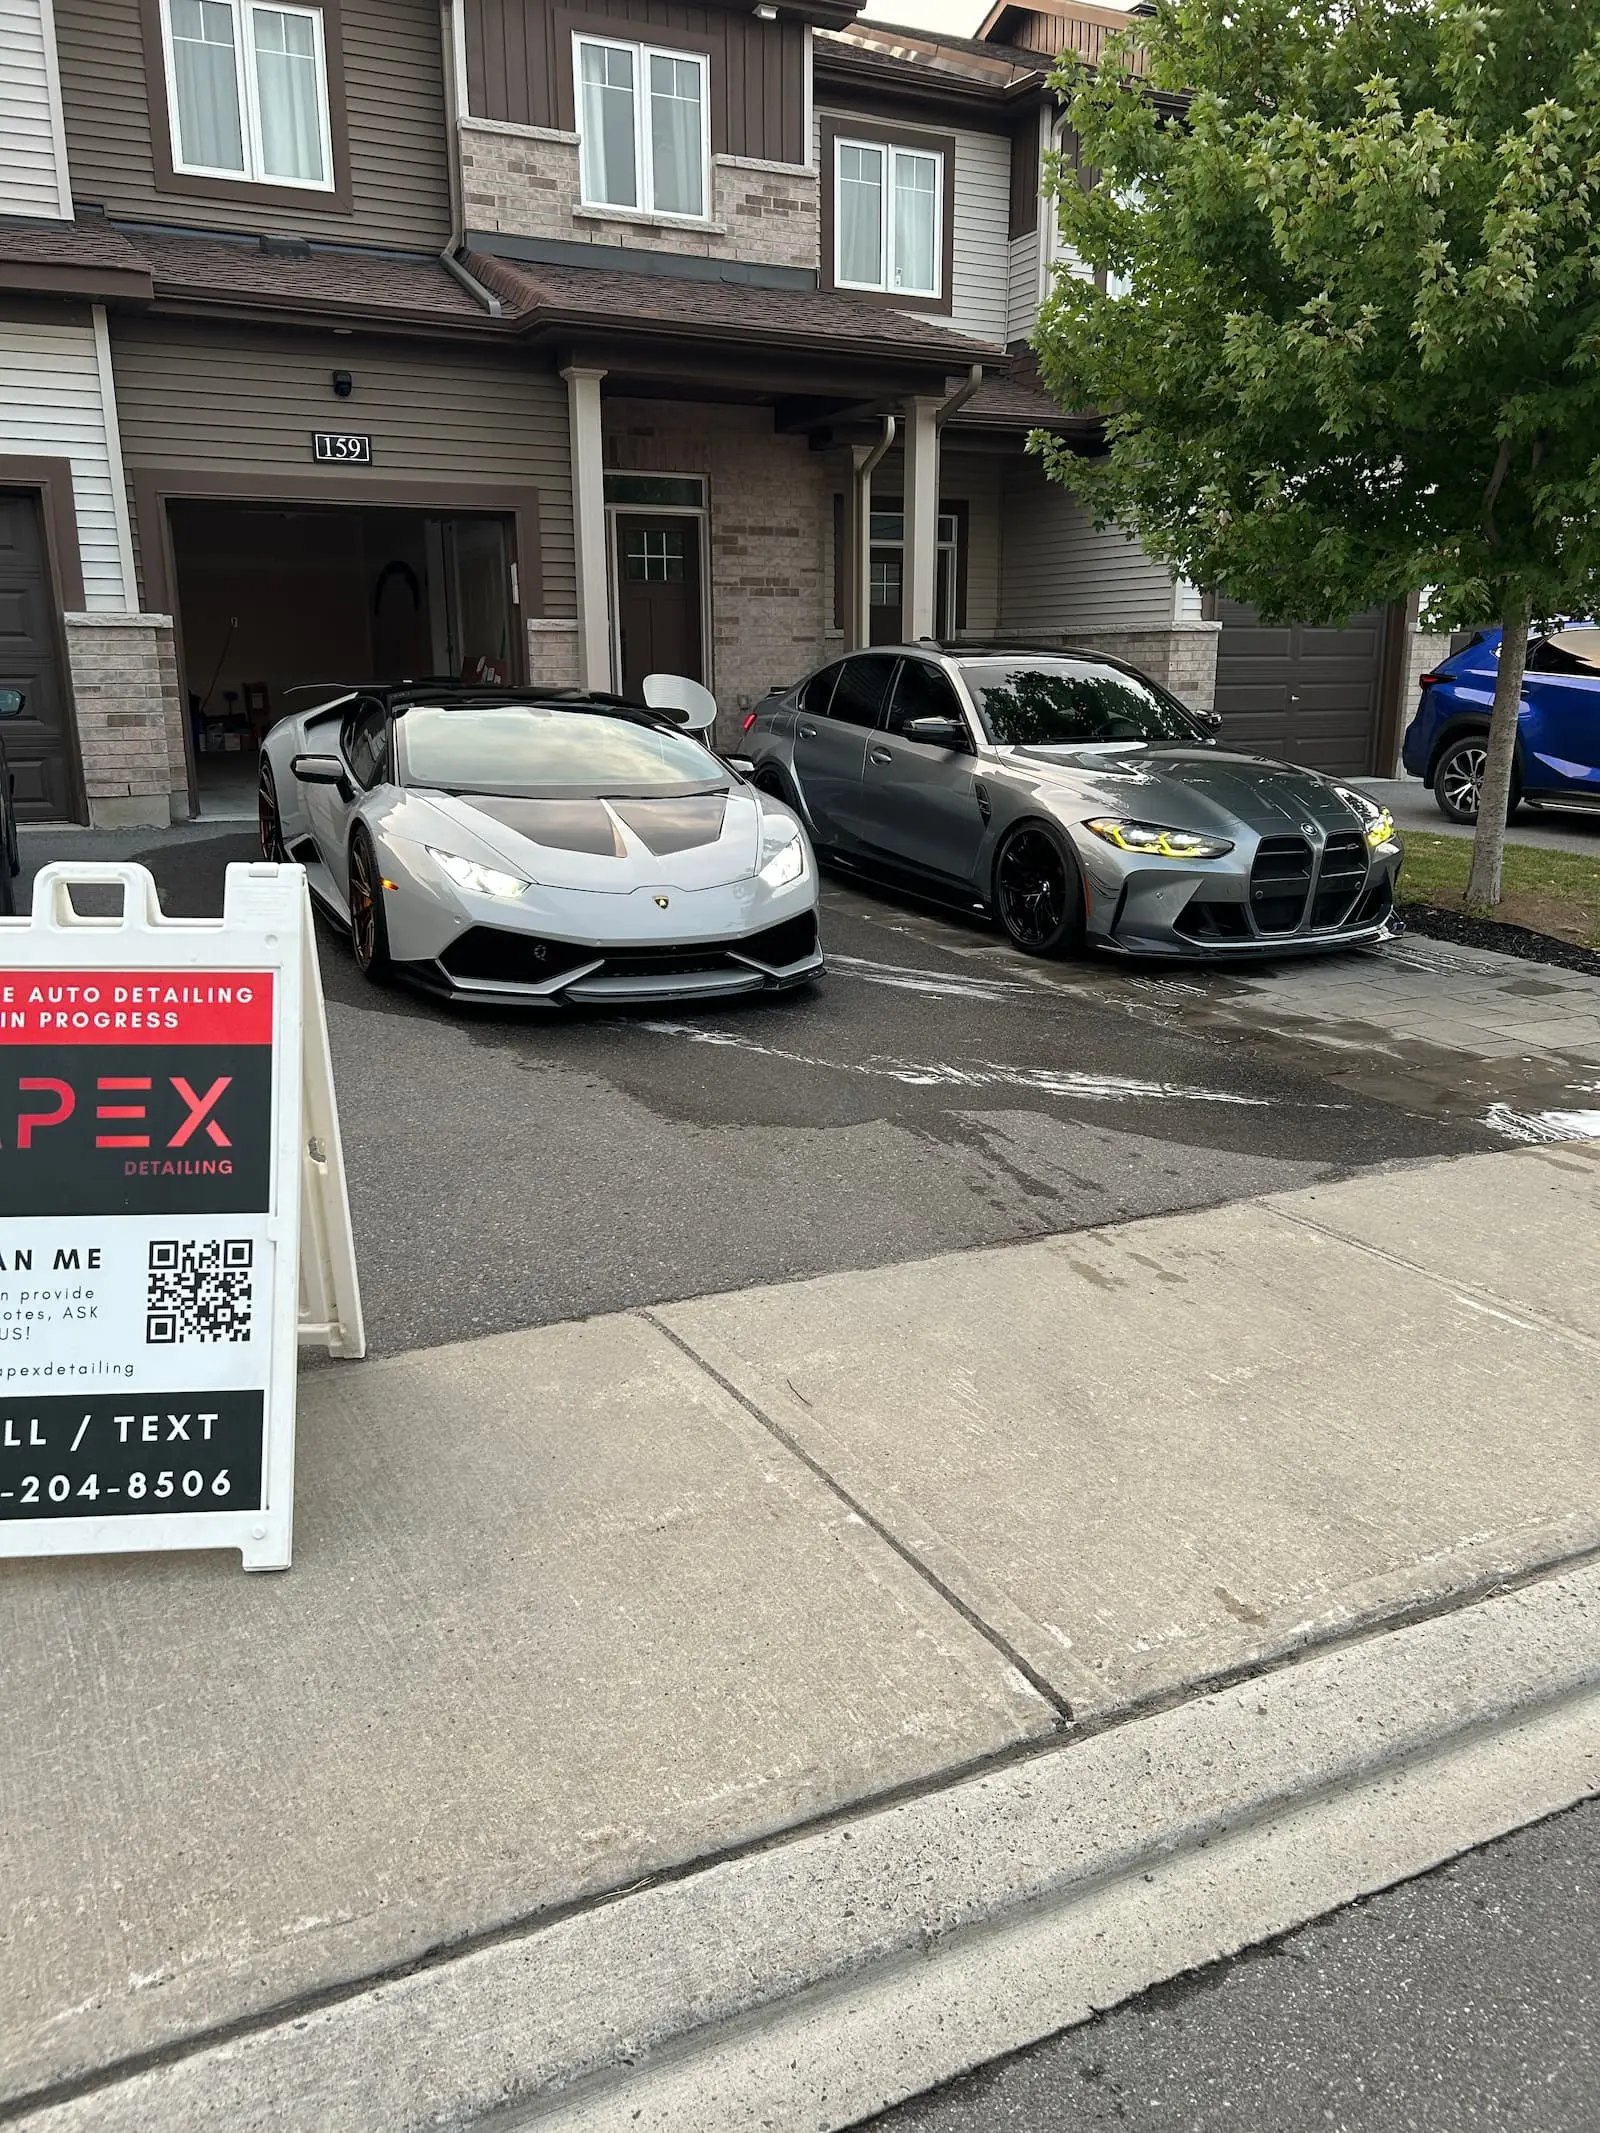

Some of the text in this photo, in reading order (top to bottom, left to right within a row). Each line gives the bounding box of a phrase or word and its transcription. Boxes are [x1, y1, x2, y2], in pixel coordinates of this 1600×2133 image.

[324, 436, 361, 459] 159
[28, 986, 100, 1003] AUTO
[114, 987, 253, 1004] DETAILING
[0, 1011, 179, 1029] IN PROGRESS
[0, 1077, 233, 1149] PEX
[124, 1159, 233, 1176] DETAILING
[53, 1248, 101, 1270] ME
[20, 1285, 95, 1305] provide
[62, 1306, 98, 1320] ASK
[0, 1326, 30, 1341] US!
[4, 1413, 219, 1452] LL / TEXT
[0, 1469, 231, 1503] -204-8506
